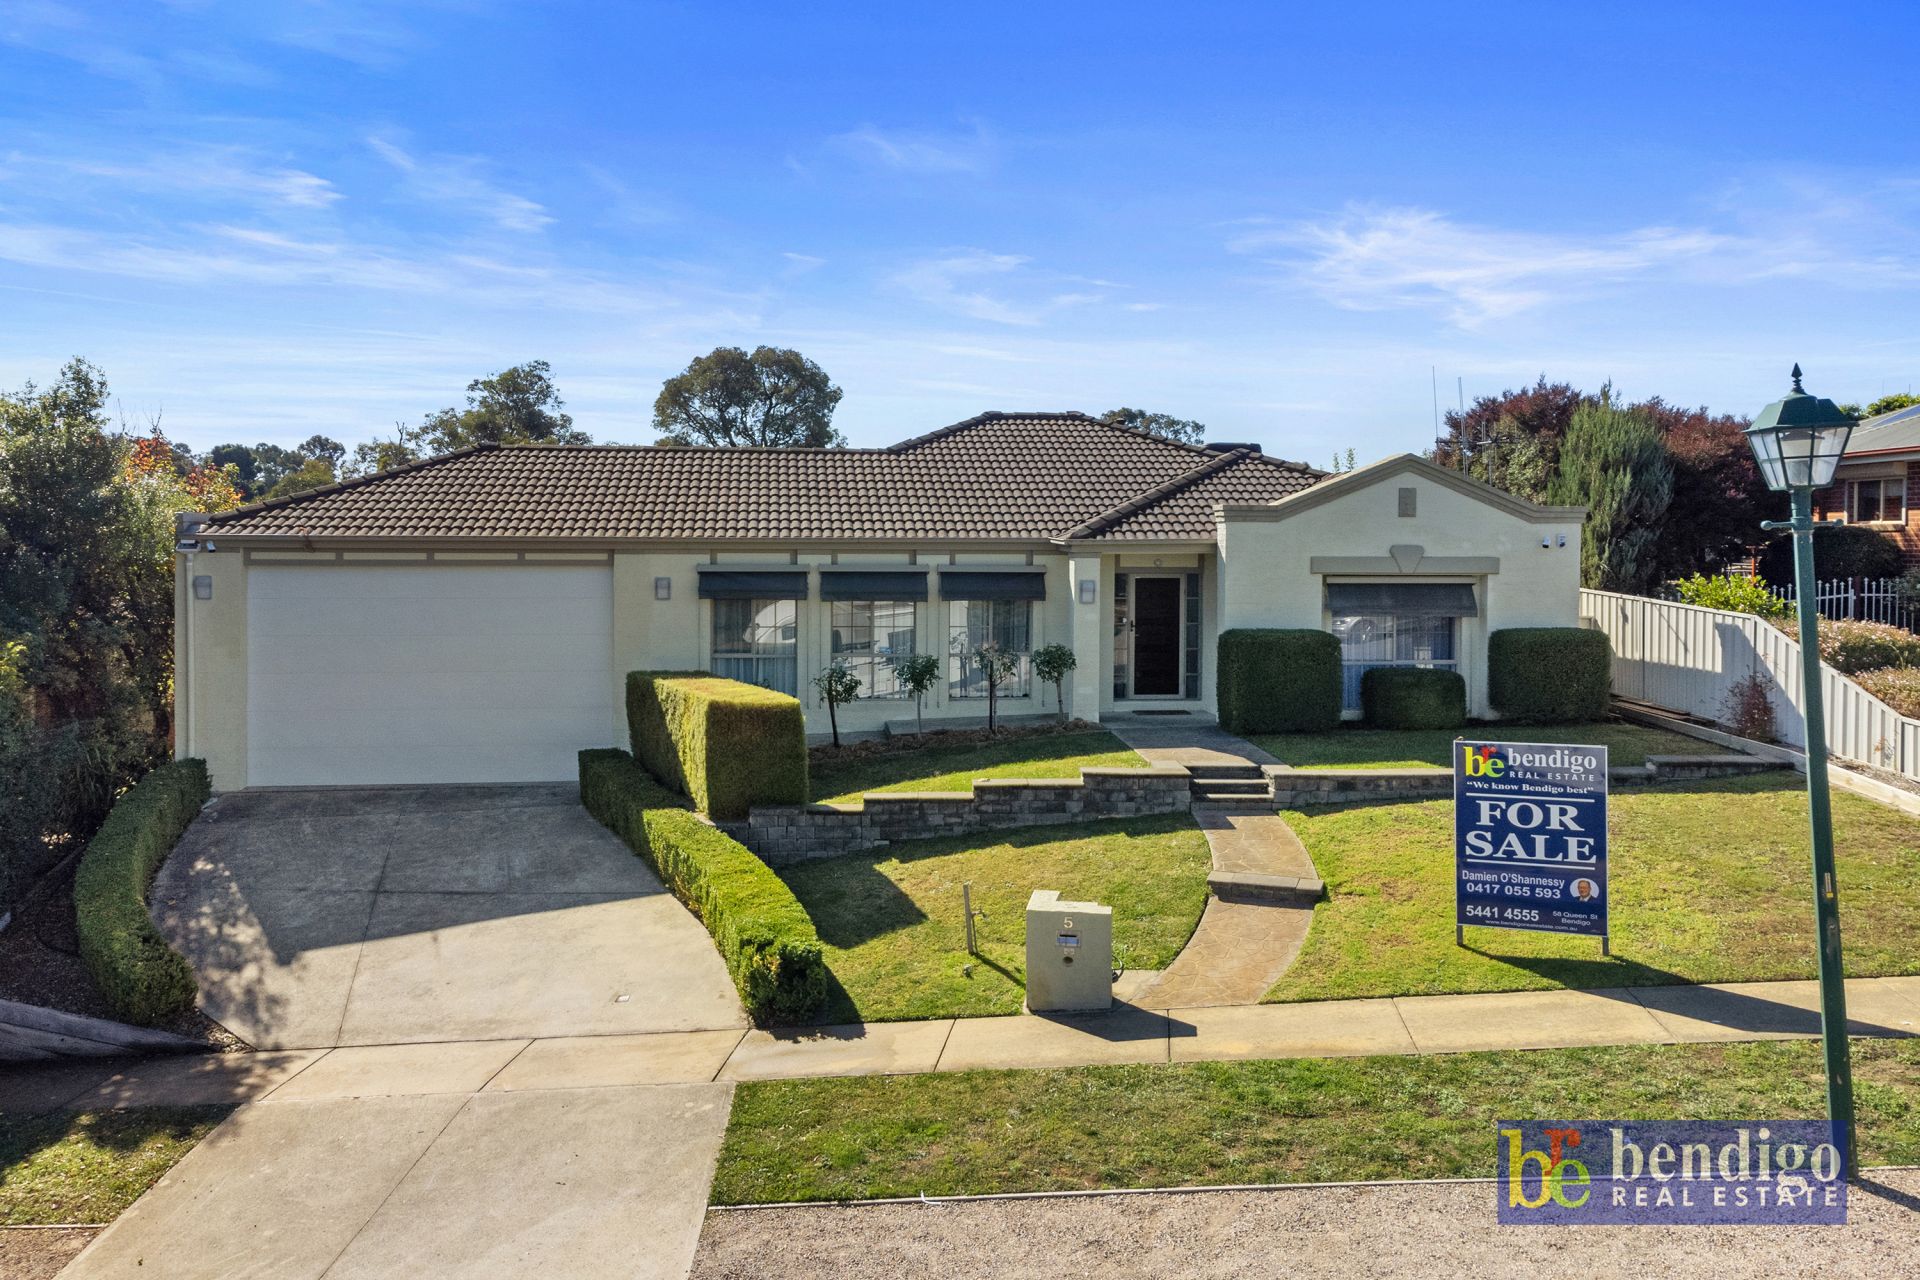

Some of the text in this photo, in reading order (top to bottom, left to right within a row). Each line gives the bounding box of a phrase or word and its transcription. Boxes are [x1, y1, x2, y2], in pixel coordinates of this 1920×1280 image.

[1507, 748, 1597, 773] bendigo
[1547, 773, 1595, 781] ESTATE
[1491, 782, 1519, 790] know
[1522, 784, 1564, 794] Bendigo
[1475, 800, 1585, 831] FOR
[1465, 830, 1597, 863] SALE
[1462, 870, 1498, 882] Damien
[1466, 883, 1561, 898] 0417 055 593
[1465, 905, 1540, 922] 5441 4555
[1064, 916, 1074, 928] 5
[1562, 918, 1591, 926] Bendigo
